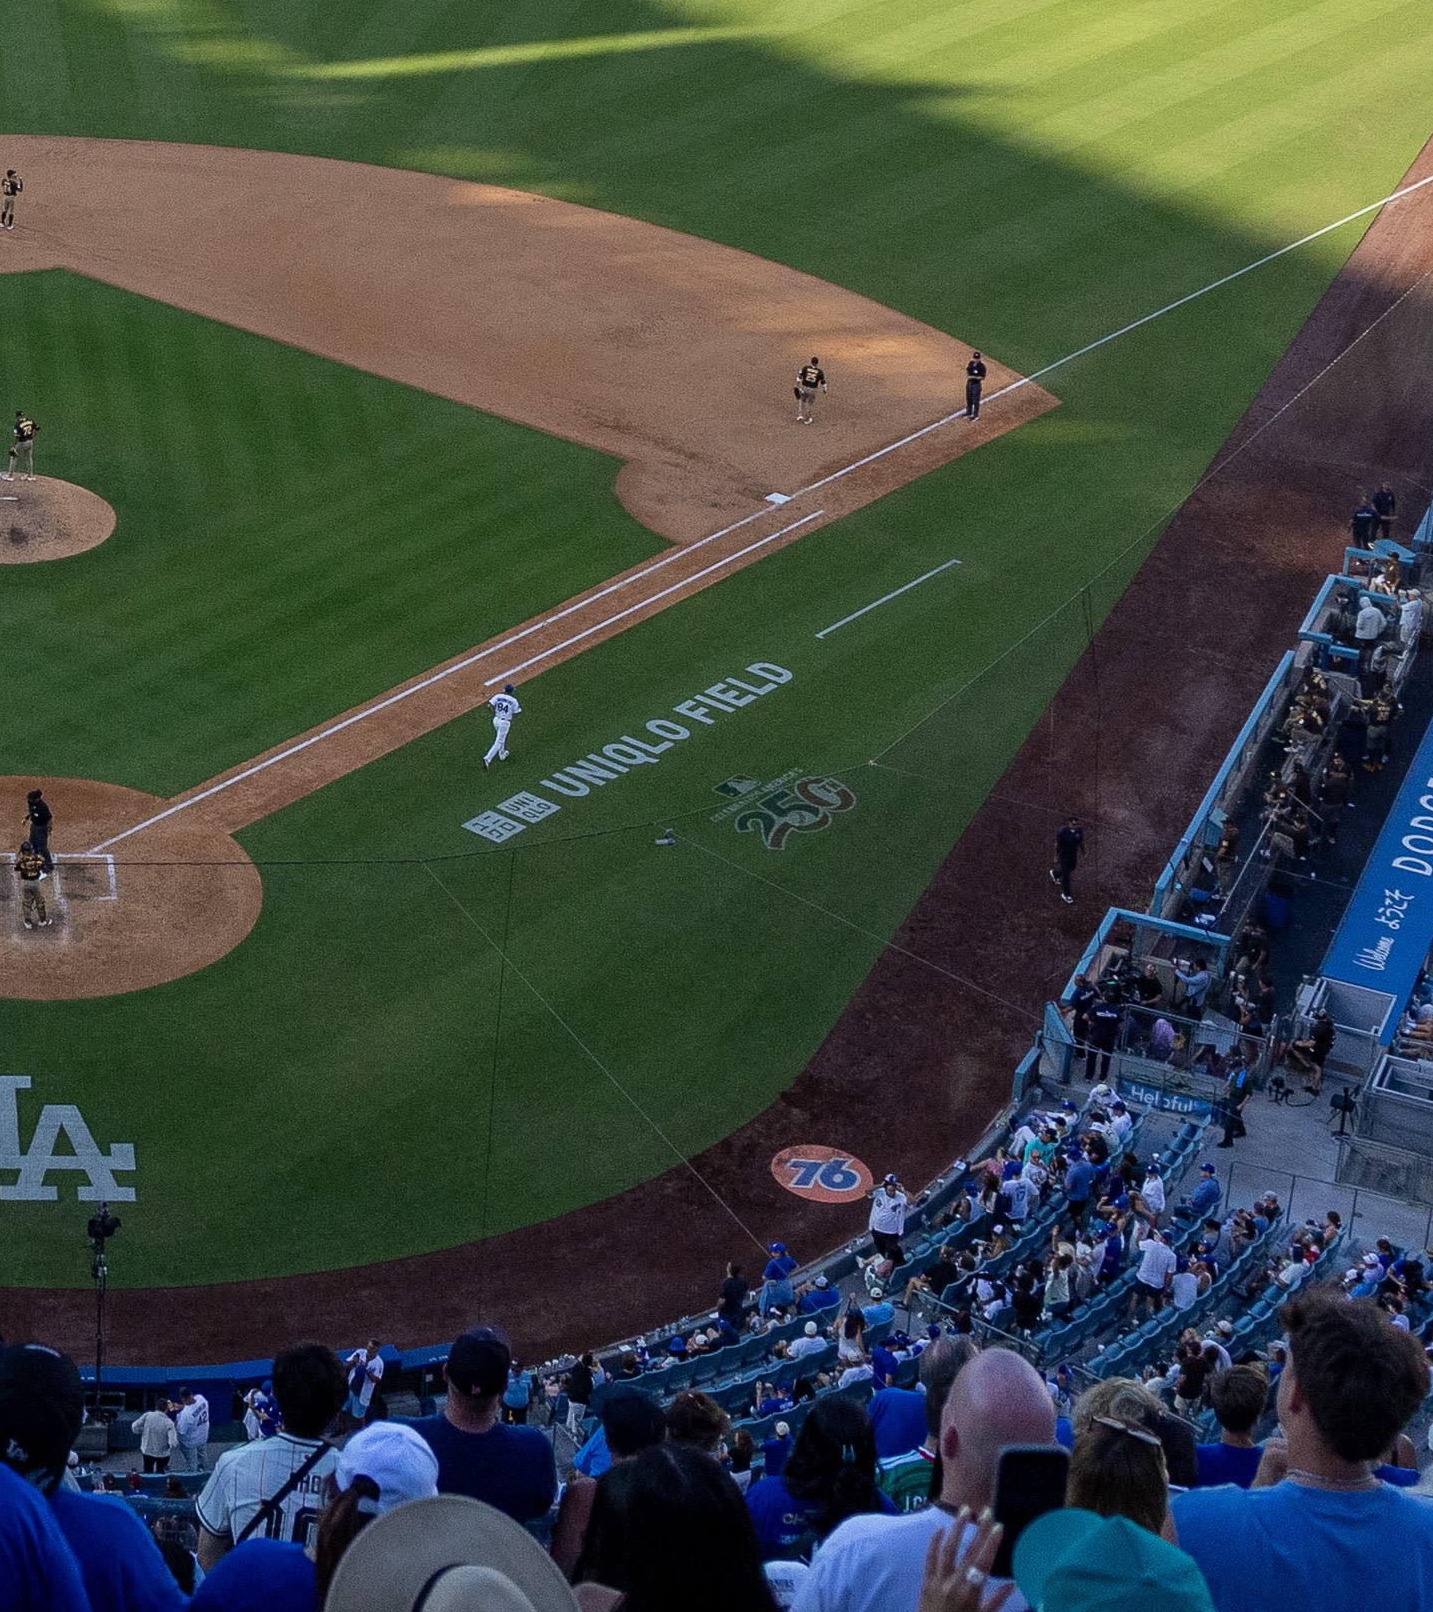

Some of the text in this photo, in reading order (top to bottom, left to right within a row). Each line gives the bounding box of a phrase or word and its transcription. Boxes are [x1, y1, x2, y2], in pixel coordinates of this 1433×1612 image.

[497, 702, 509, 714] 84
[673, 662, 794, 726] FIELD
[540, 719, 691, 798] UNIQLO
[507, 795, 535, 814] UNI
[522, 803, 552, 819] QLO
[736, 775, 857, 850] 250
[1374, 887, 1415, 930] ようこそ
[1352, 935, 1396, 972] Welcome
[789, 1157, 862, 1192] 76
